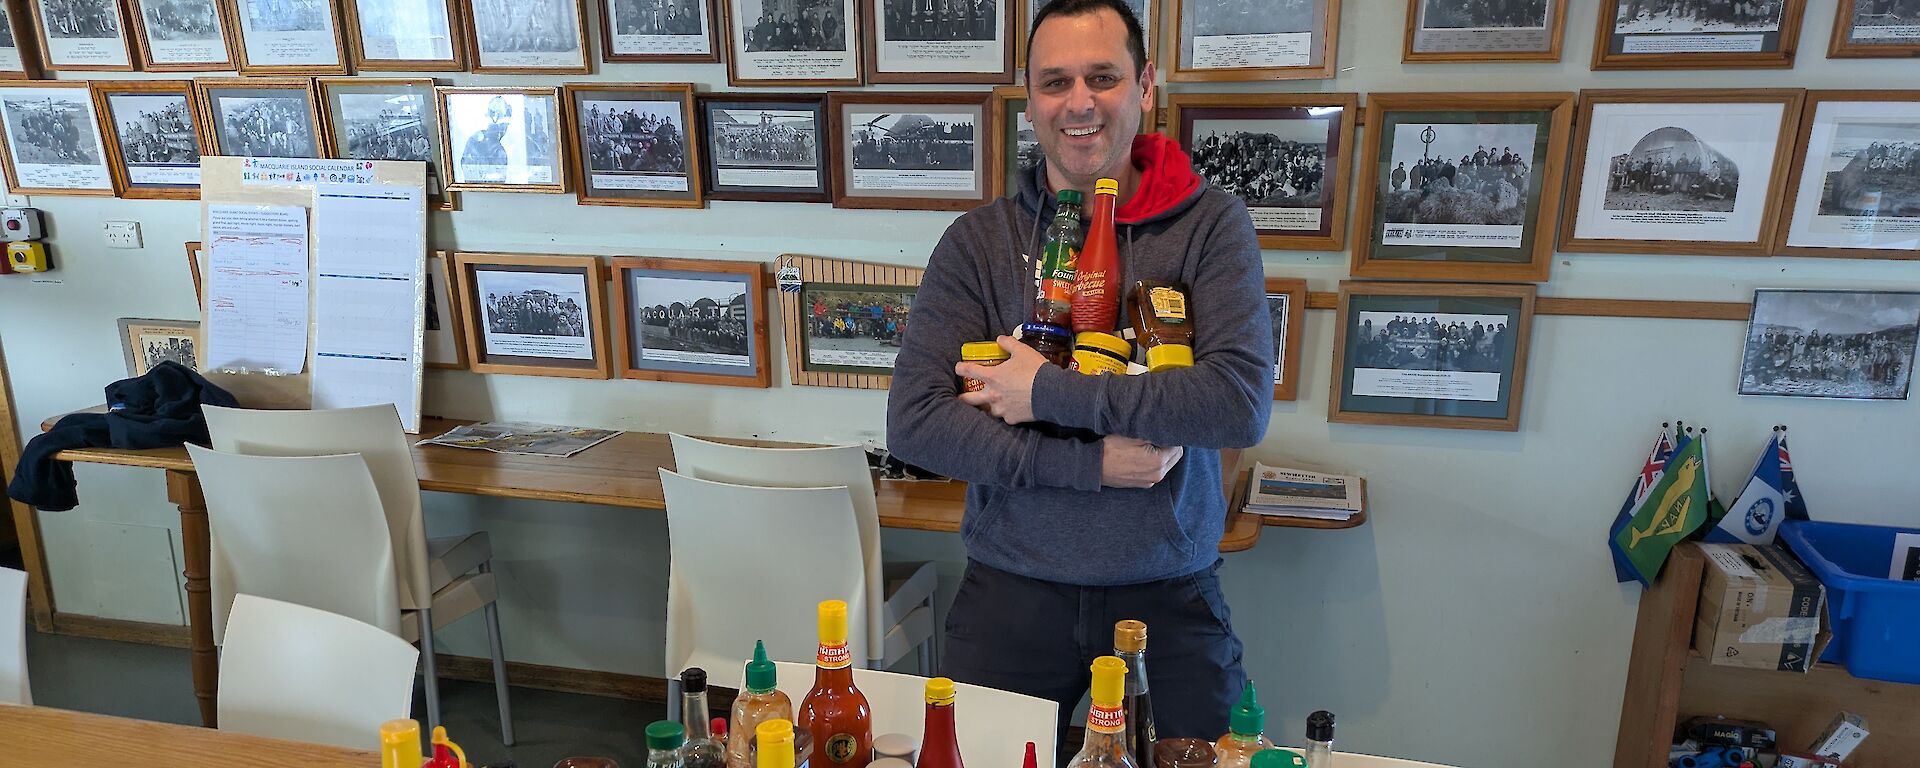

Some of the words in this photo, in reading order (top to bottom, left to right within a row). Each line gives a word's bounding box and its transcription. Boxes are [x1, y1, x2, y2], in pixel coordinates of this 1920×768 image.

[1052, 269, 1074, 281] Foun
[1077, 270, 1107, 282] Original
[1053, 280, 1070, 289] SWEET
[1280, 471, 1316, 479] NEWSLETTER
[1800, 596, 1811, 618] CODE
[824, 653, 850, 662] STRONG
[1091, 717, 1121, 727] STRONG
